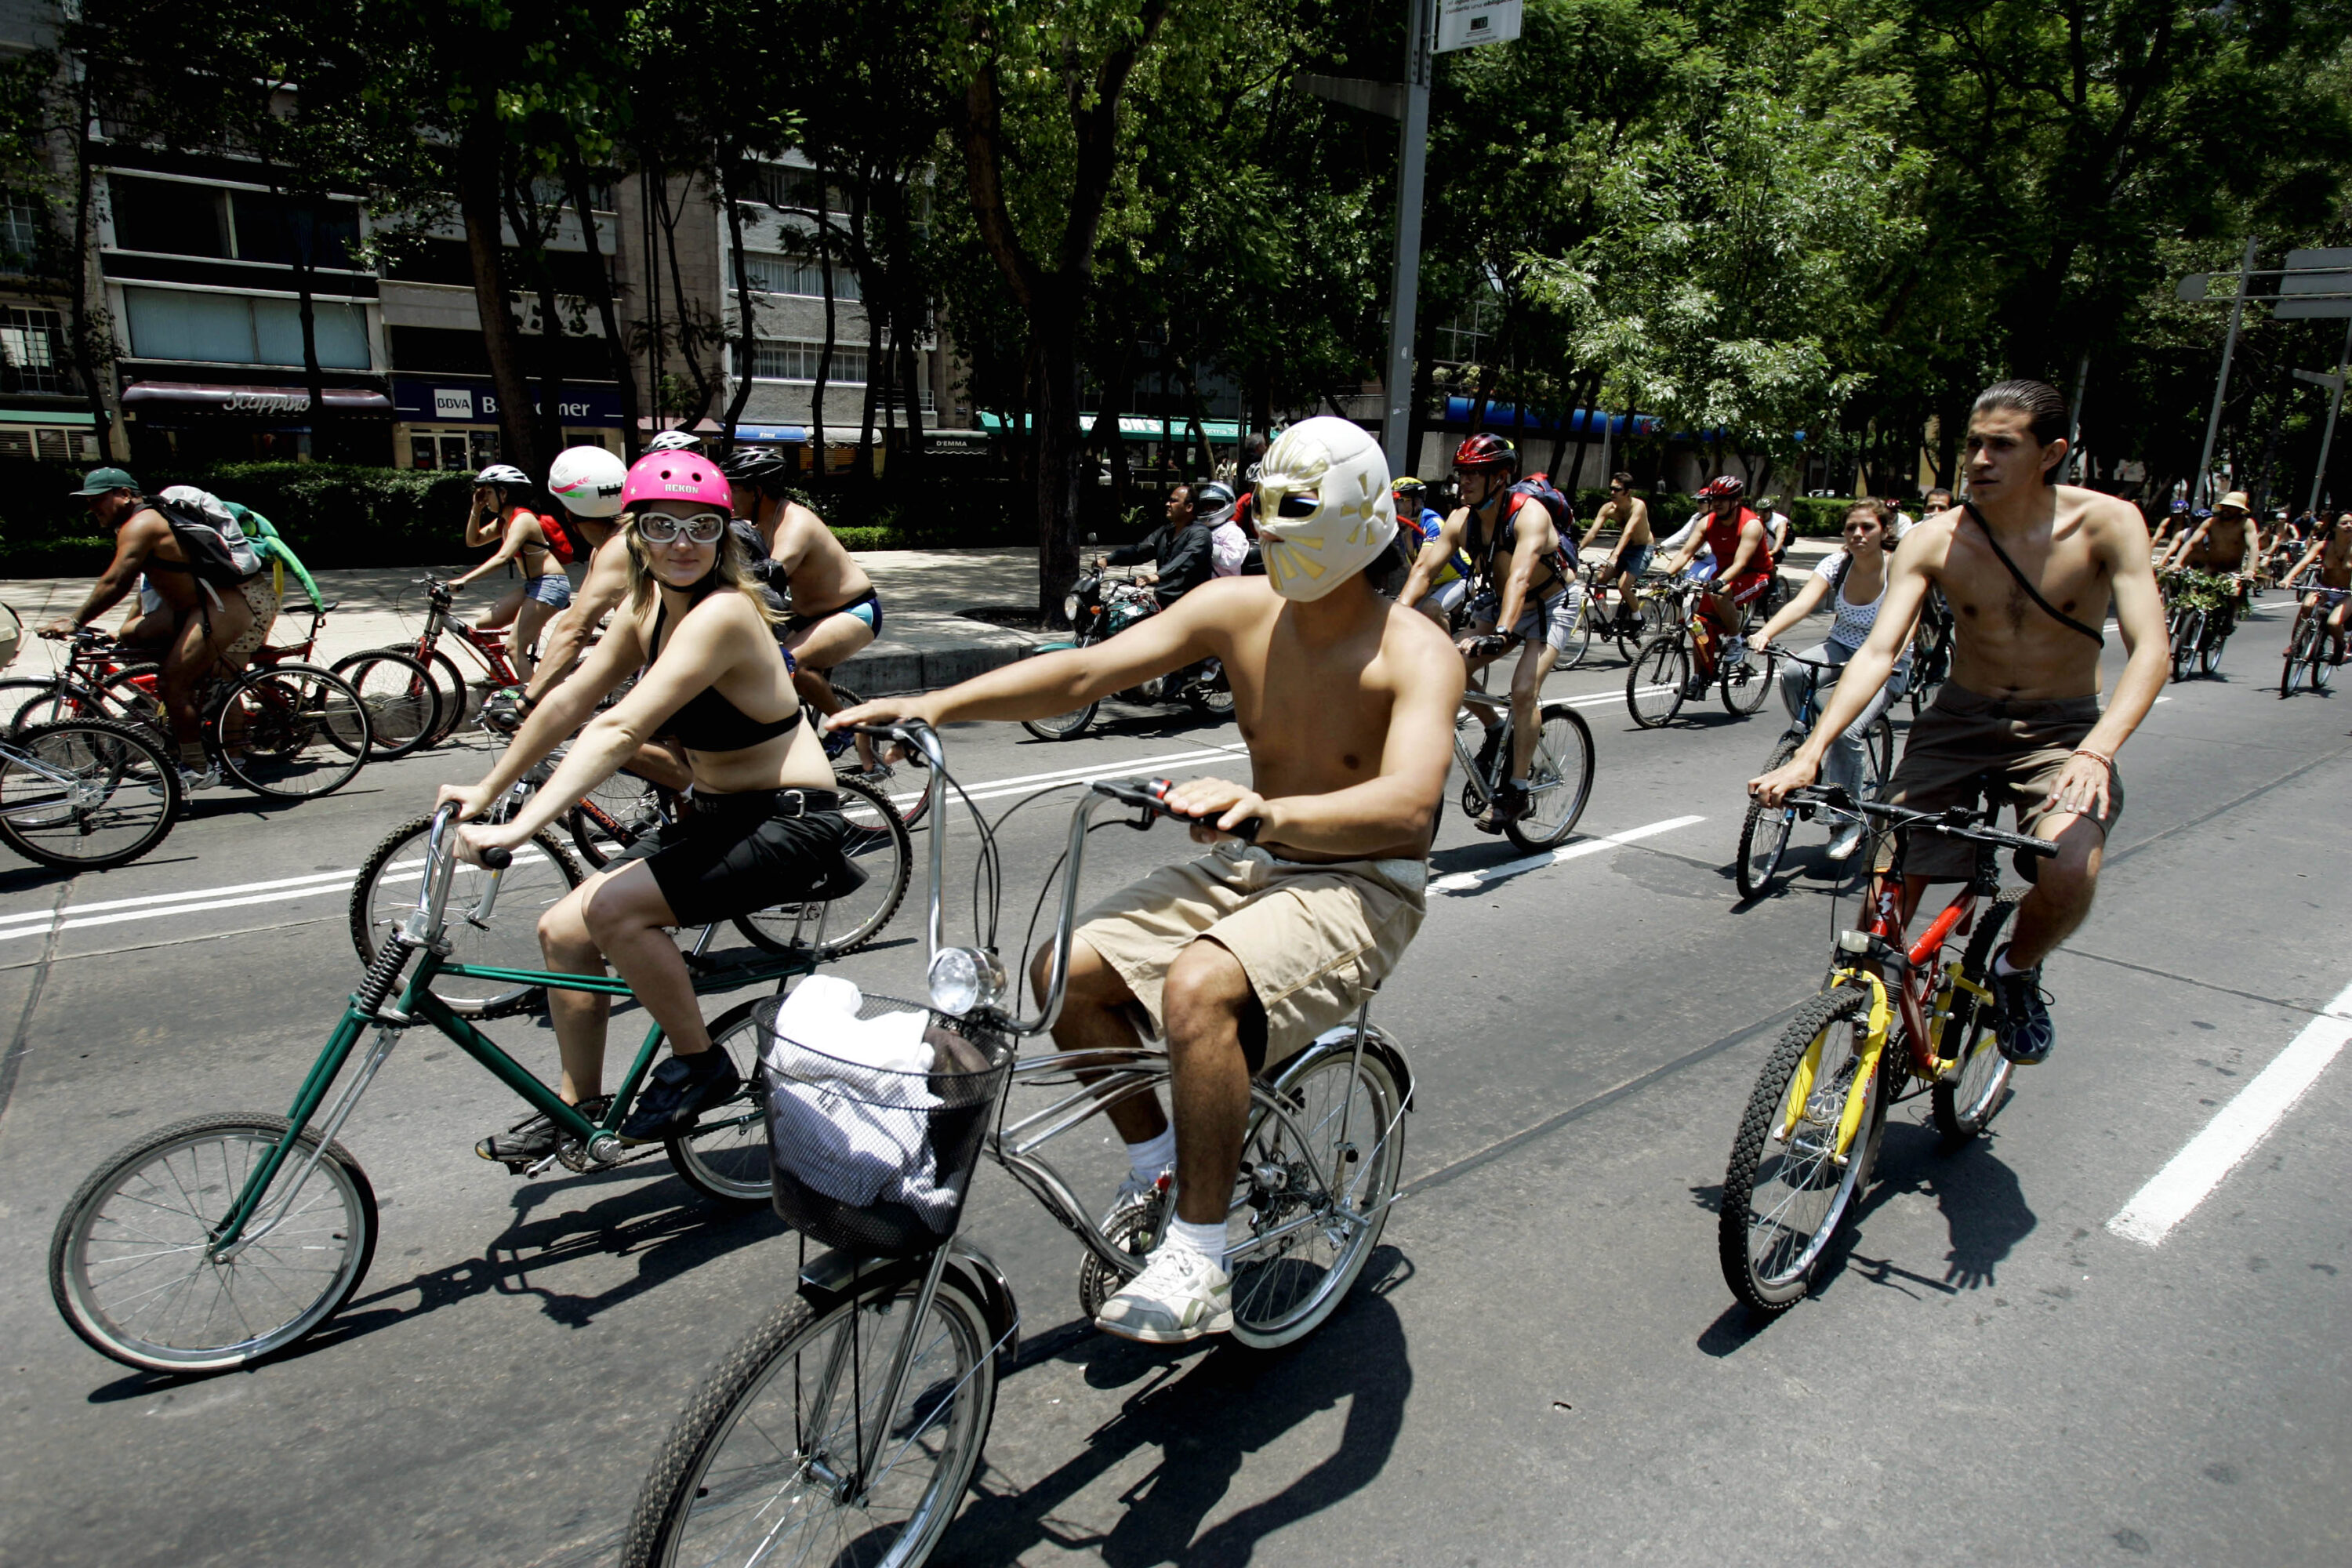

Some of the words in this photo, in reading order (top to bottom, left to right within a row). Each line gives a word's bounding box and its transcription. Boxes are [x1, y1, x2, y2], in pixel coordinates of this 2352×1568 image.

[223, 393, 310, 414] Scappino
[437, 397, 470, 408] BBVA
[665, 484, 699, 494] REKON
